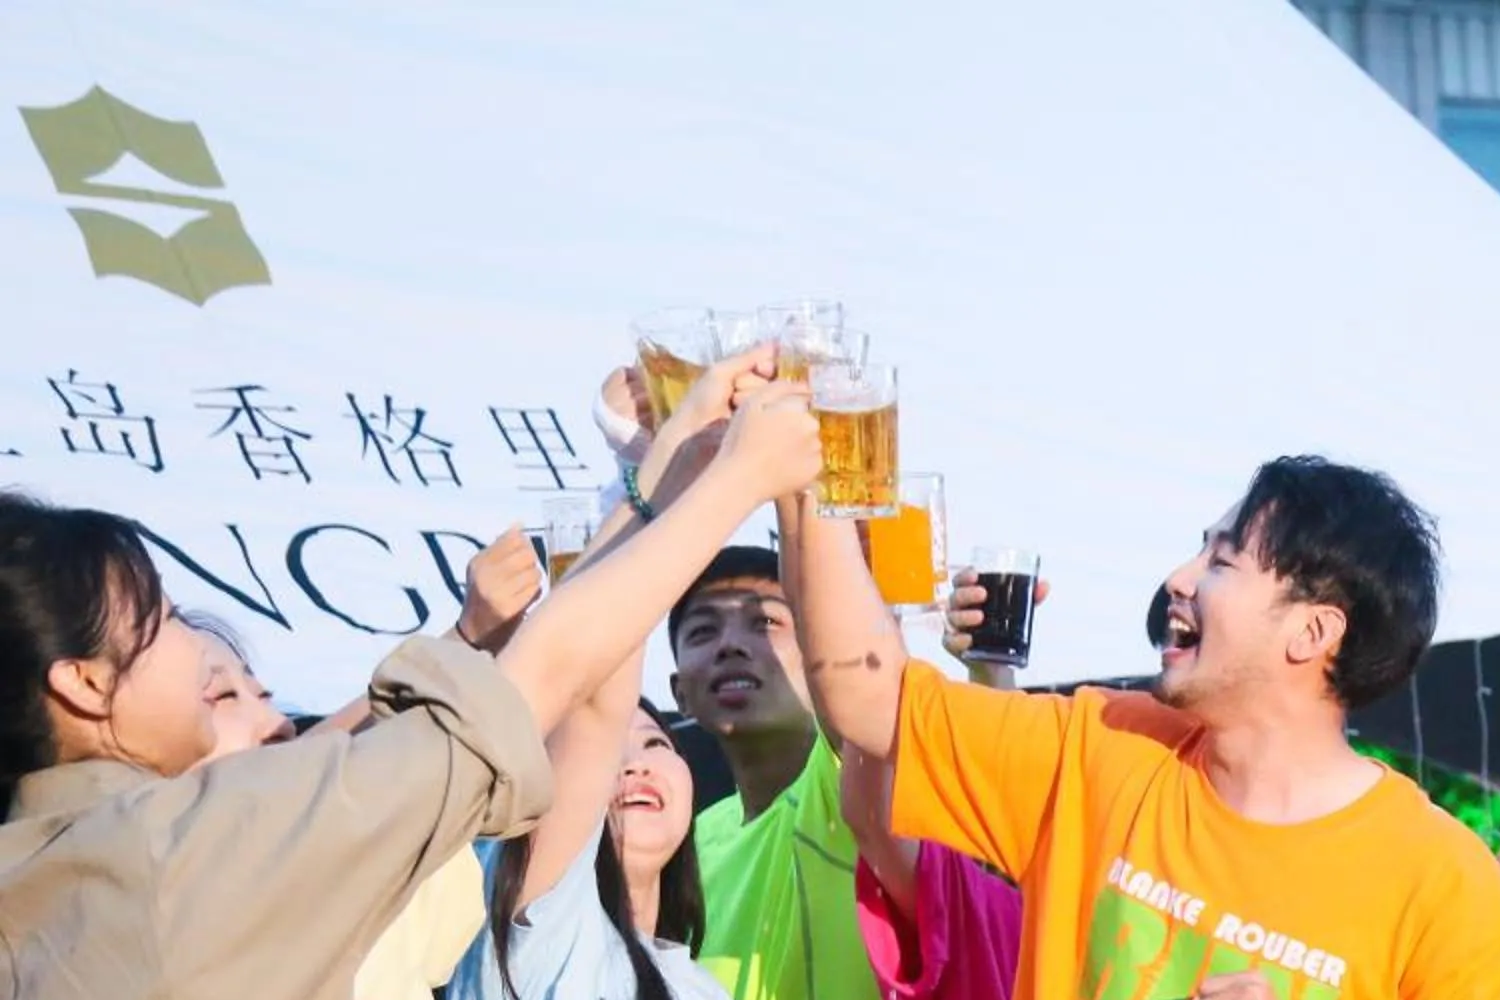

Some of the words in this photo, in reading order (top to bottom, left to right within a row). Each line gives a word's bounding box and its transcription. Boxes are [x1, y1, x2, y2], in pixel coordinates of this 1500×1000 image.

[0, 368, 602, 491] 岛香格里
[1213, 911, 1347, 988] ROUBER
